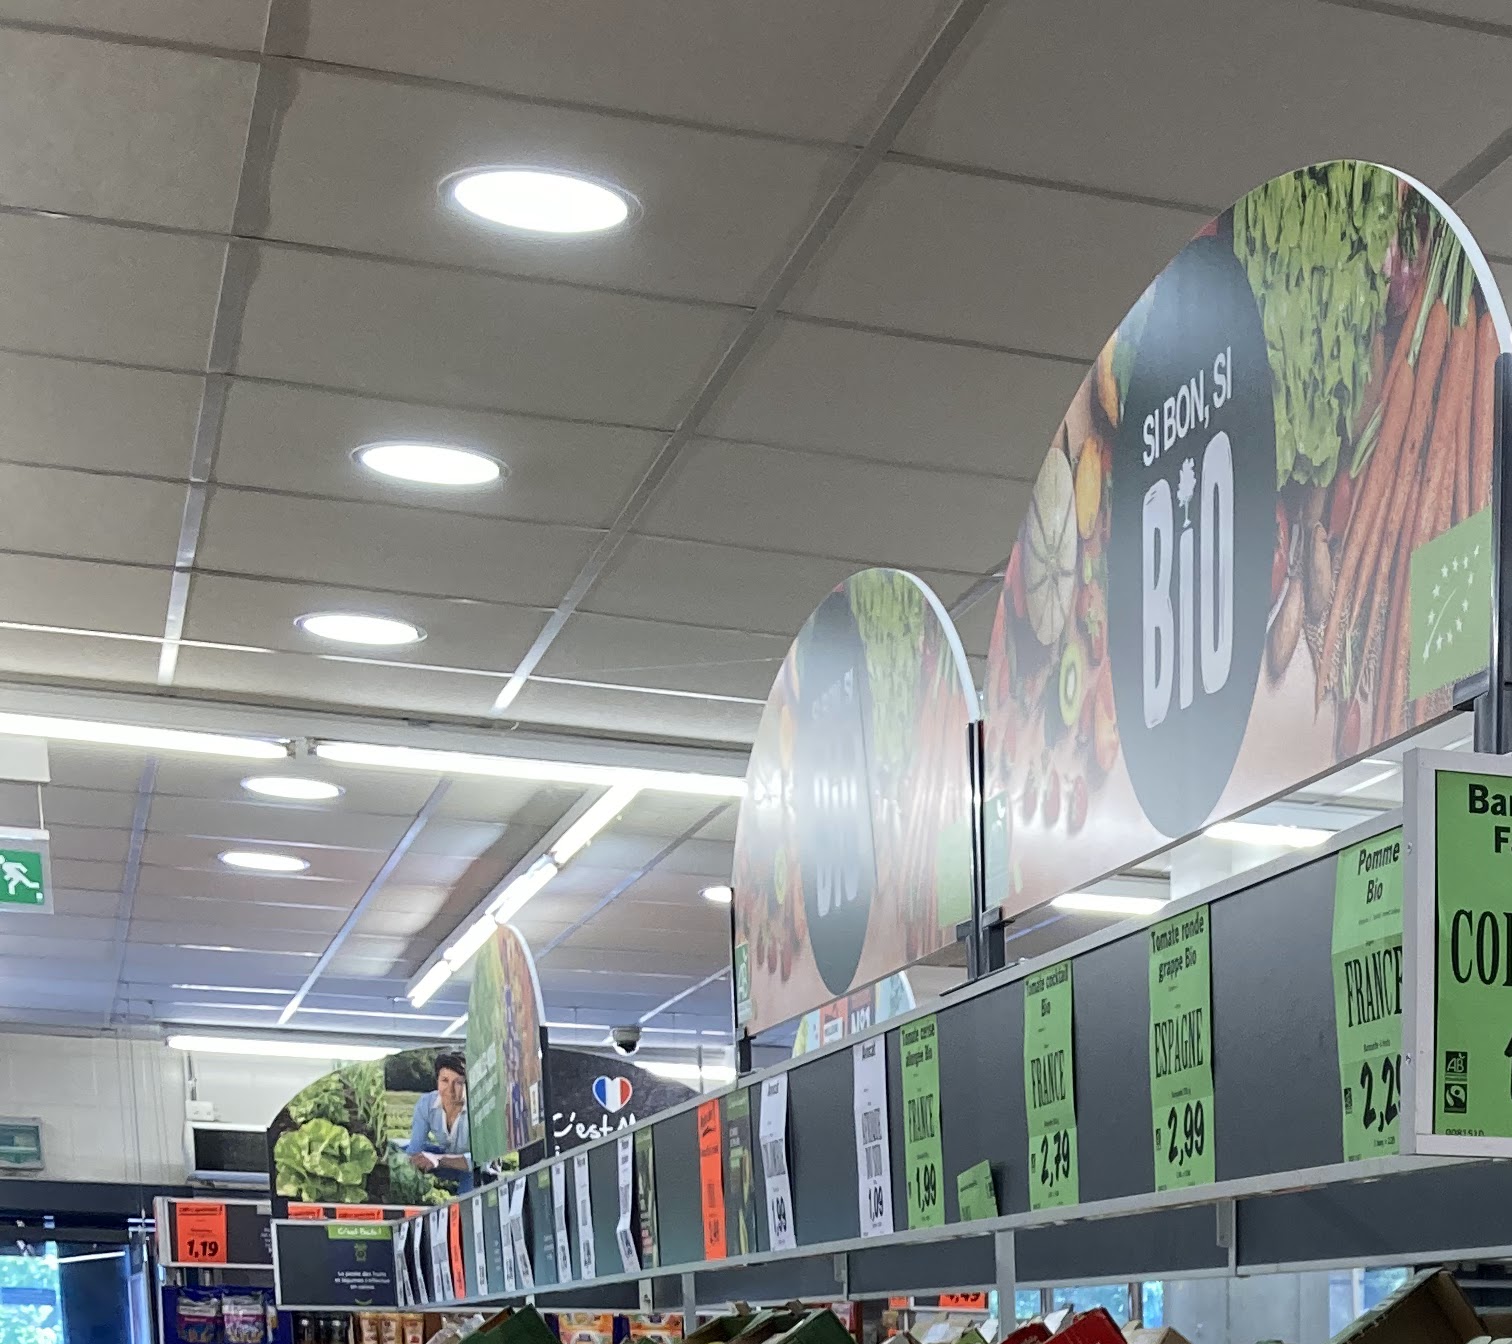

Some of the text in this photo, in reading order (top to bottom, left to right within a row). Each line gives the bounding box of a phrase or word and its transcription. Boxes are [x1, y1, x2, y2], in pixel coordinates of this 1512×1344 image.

[1142, 346, 1232, 467] SI BON, SI
[1142, 429, 1234, 729] BiO
[1357, 841, 1401, 876] Pomme
[1366, 876, 1383, 904] Bio
[1151, 914, 1204, 955] Tomate ronde
[1158, 946, 1197, 983] grappe Bio
[1153, 1007, 1204, 1079] ESPAGNE
[1030, 1049, 1067, 1110] FRANCE
[1040, 1128, 1070, 1188] 2,79
[1167, 1100, 1205, 1167] 2,99
[916, 1162, 937, 1213] 1,99
[187, 1238, 219, 1259] 1,19
